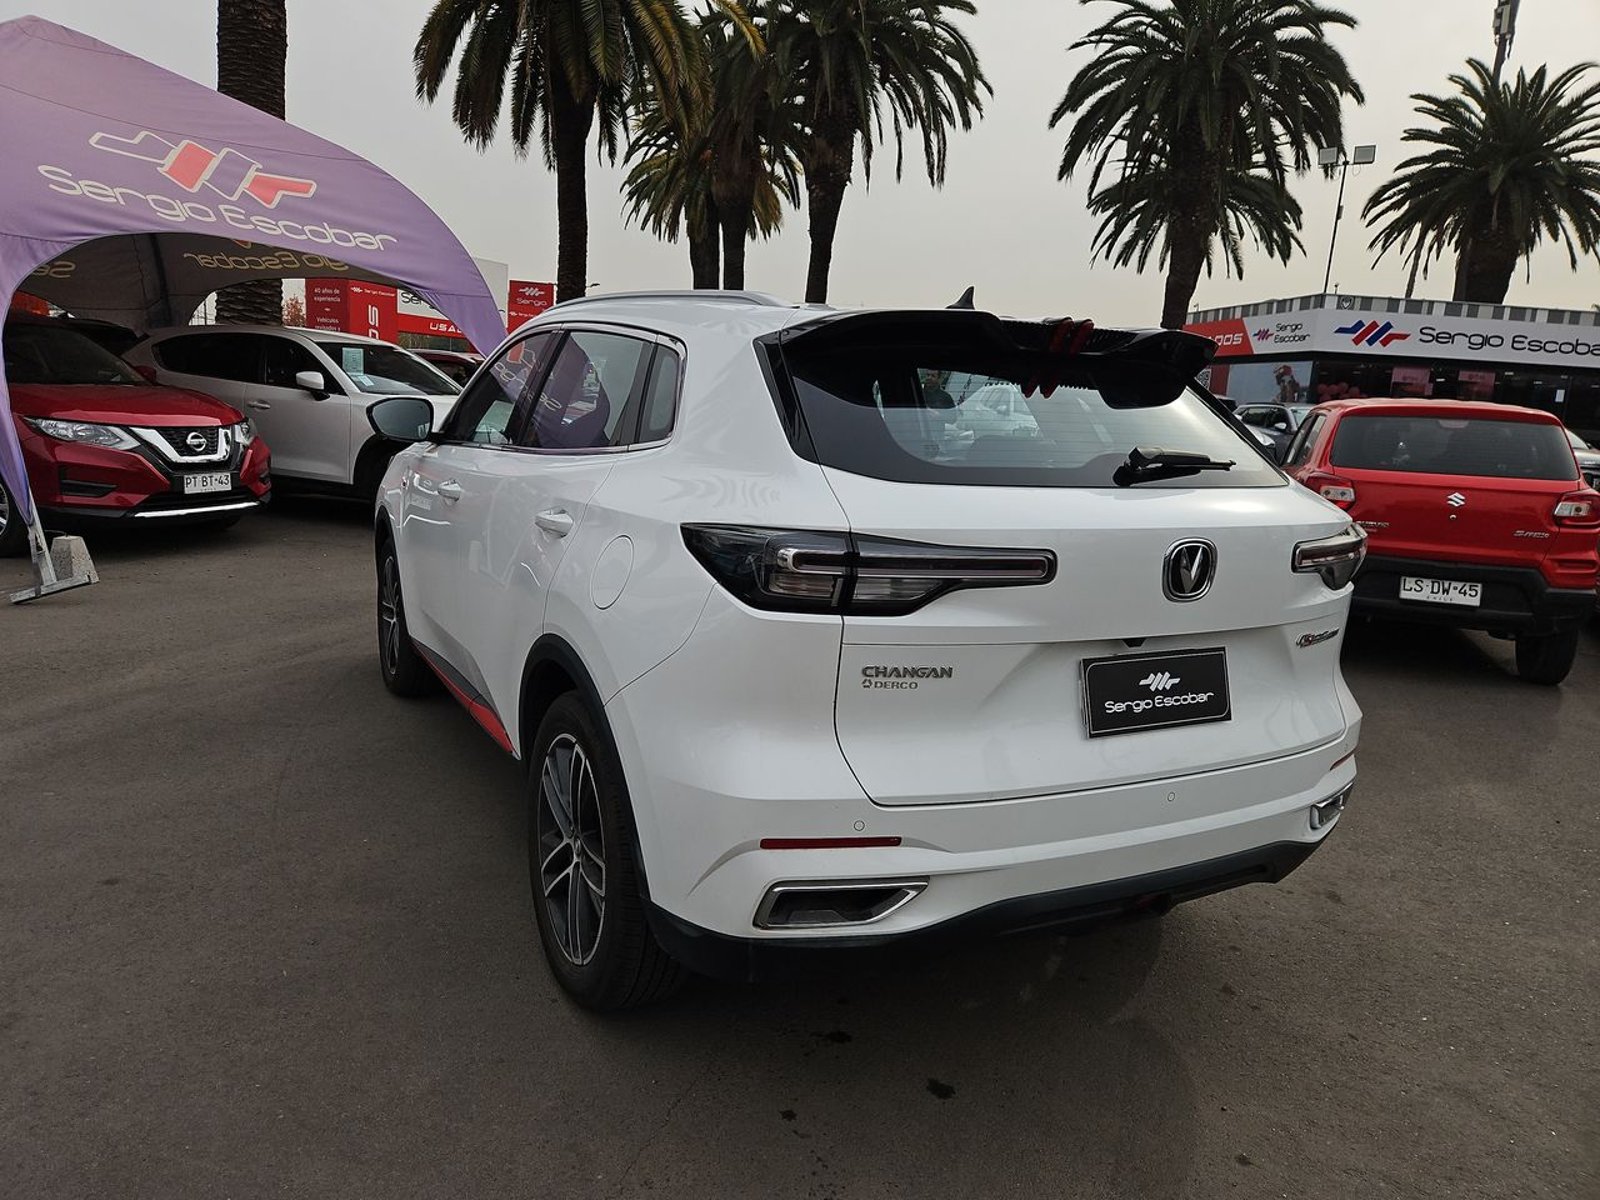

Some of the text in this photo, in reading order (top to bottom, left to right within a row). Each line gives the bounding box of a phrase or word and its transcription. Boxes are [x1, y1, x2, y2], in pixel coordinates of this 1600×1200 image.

[38, 165, 398, 250] Sergio Escobar
[1273, 333, 1311, 344] Escobar
[1419, 326, 1504, 350] Sergio
[861, 665, 953, 679] CHANGAN
[874, 681, 919, 690] DERCO
[1104, 692, 1215, 714] Sergio Escobar
